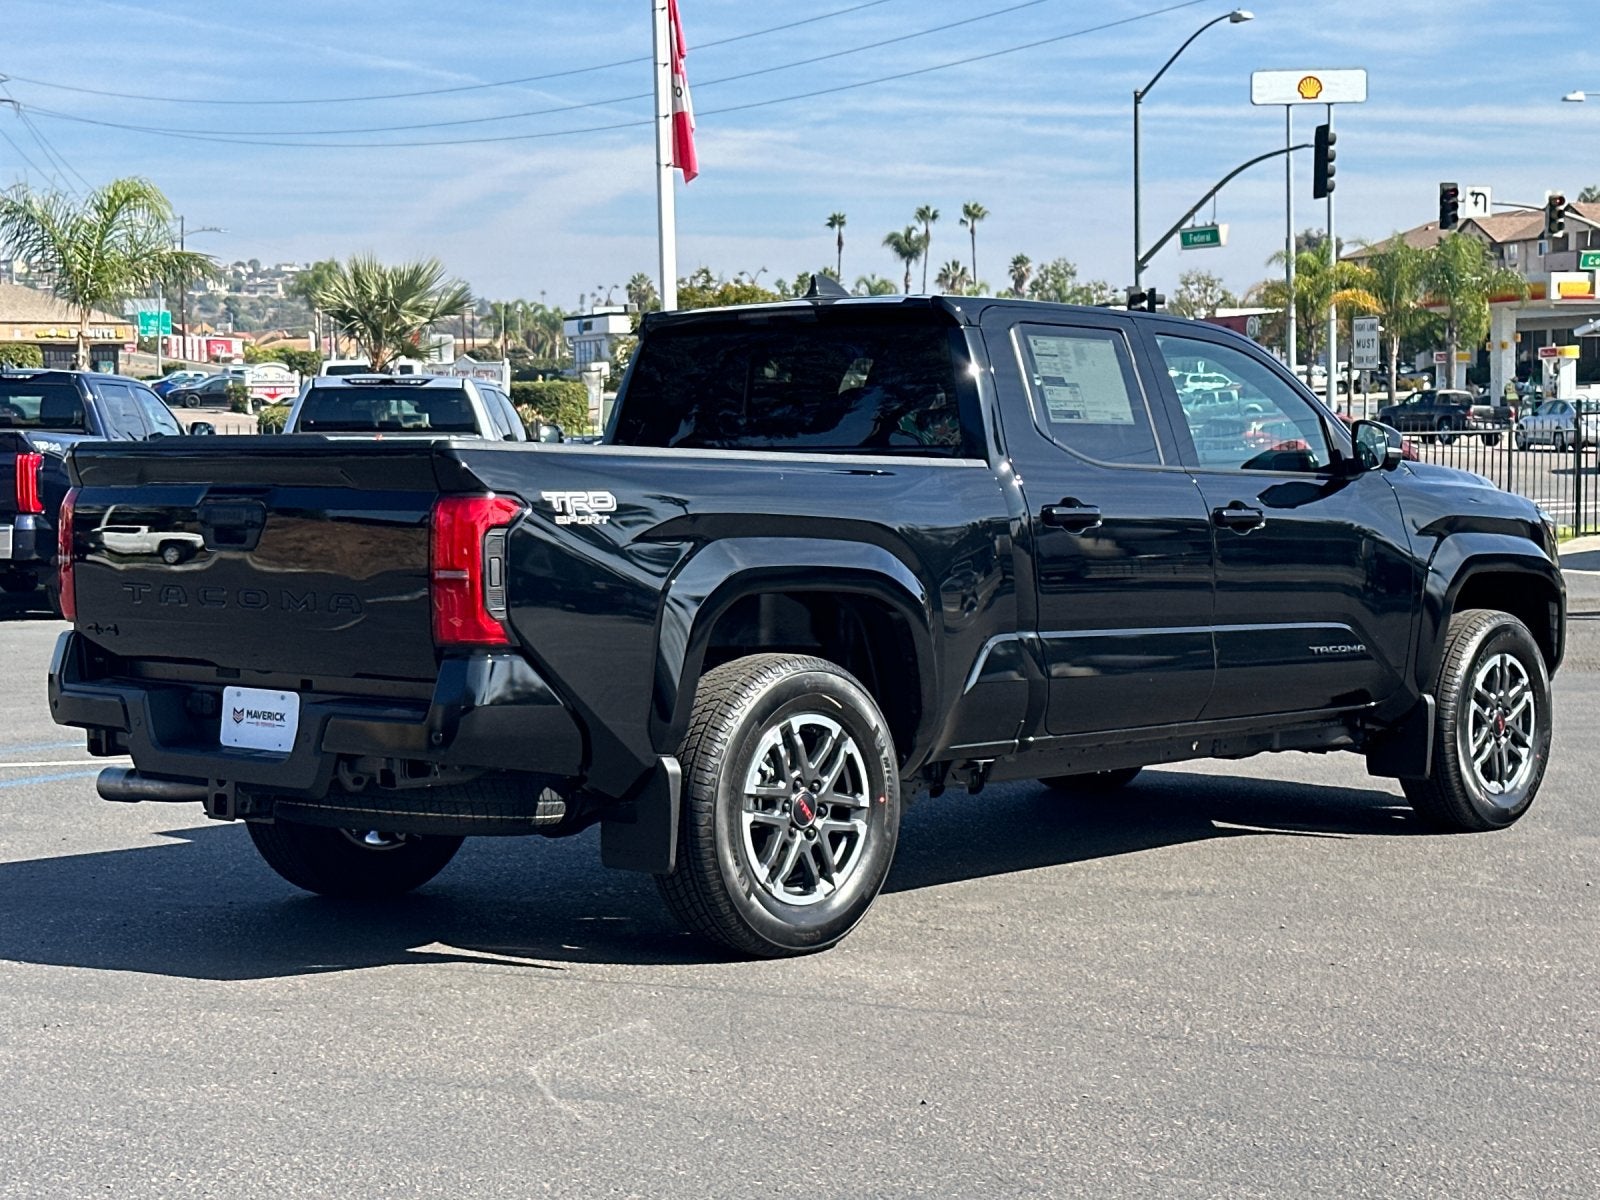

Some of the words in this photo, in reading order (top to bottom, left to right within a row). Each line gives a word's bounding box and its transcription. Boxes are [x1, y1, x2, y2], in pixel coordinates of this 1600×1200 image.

[1189, 231, 1211, 243] Federal
[1356, 338, 1376, 348] MUST
[541, 491, 617, 516] TRD
[554, 514, 611, 525] SPORT
[122, 582, 362, 615] TACOMA
[1308, 644, 1367, 655] TACOMA
[246, 709, 286, 722] MAVERICK
